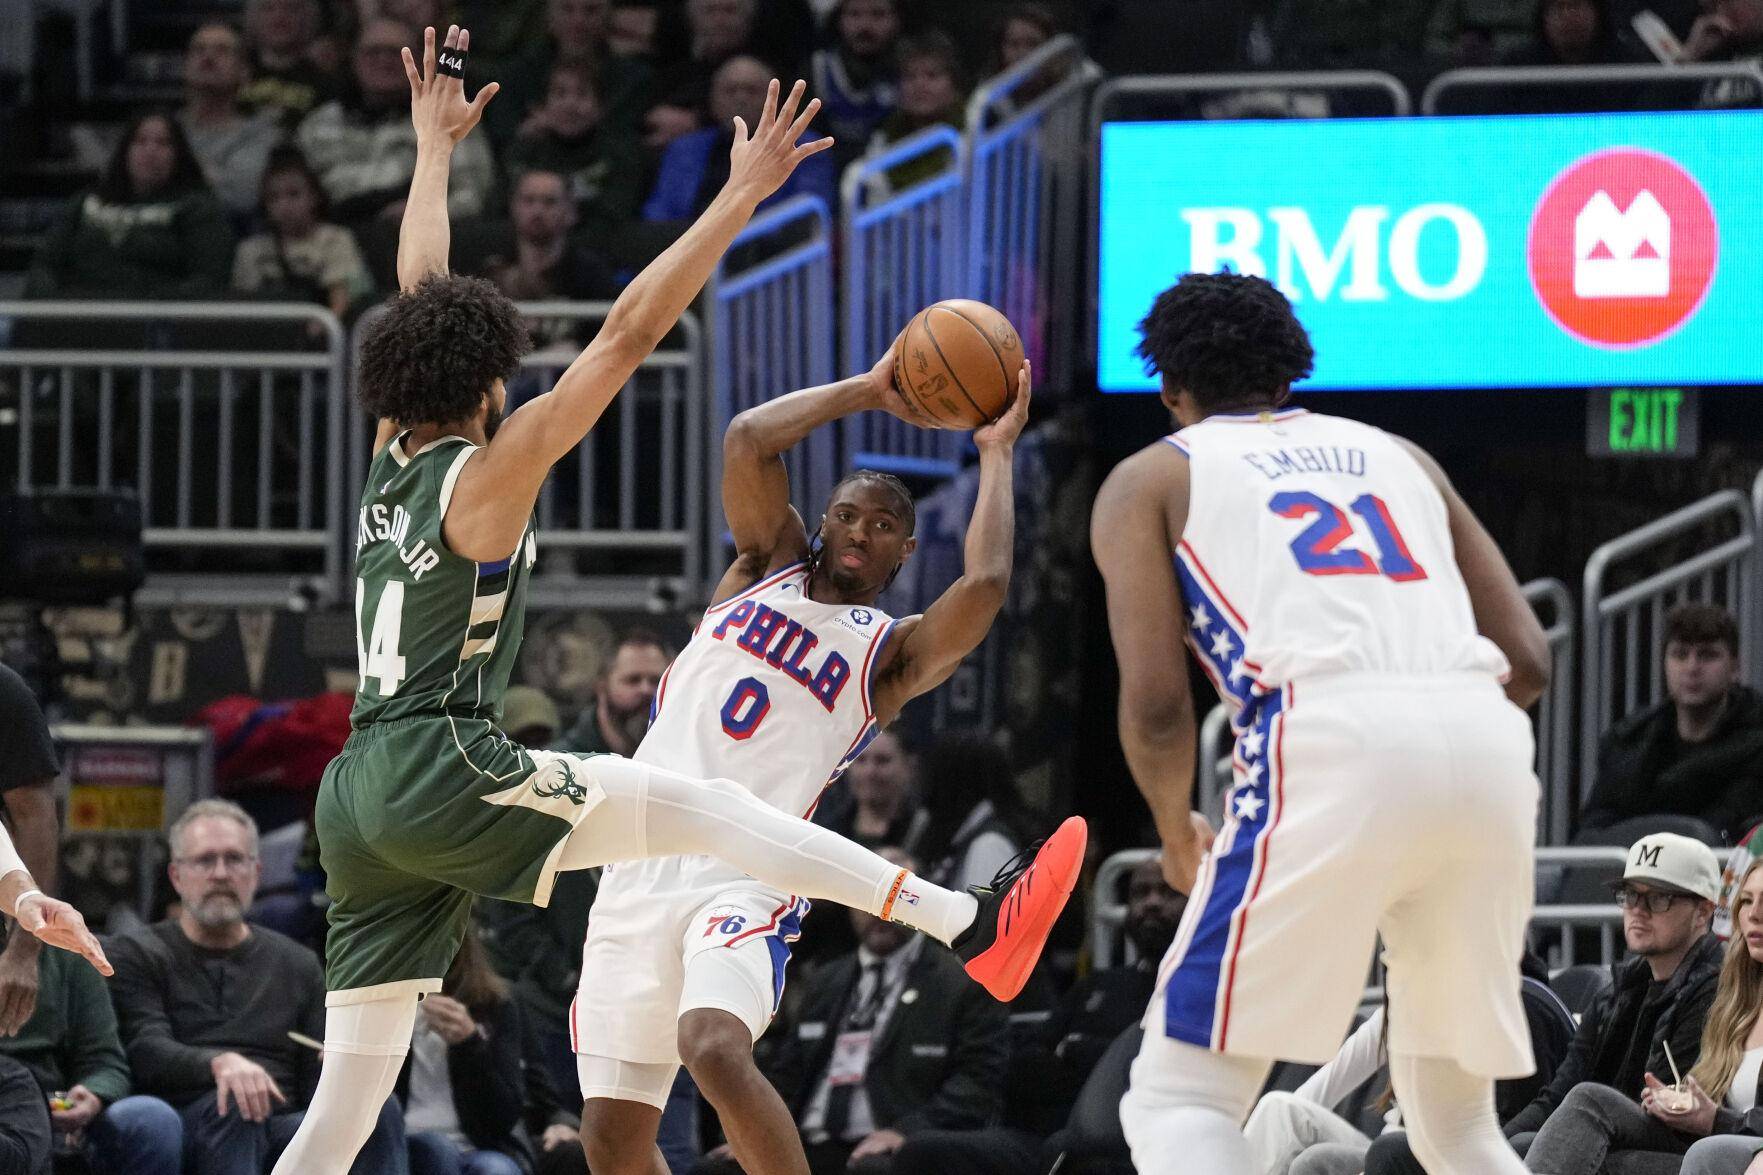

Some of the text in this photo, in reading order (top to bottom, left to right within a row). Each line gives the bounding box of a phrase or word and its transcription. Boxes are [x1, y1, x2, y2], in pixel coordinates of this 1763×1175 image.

[1180, 203, 1488, 302] BMO
[1609, 389, 1682, 452] EXIT
[1244, 446, 1365, 480] EMBIID
[400, 539, 440, 581] JR
[1268, 491, 1428, 582] 21
[712, 600, 850, 713] PHILA
[720, 677, 771, 741] 0
[1635, 844, 1664, 868] M
[703, 915, 747, 937] 76
